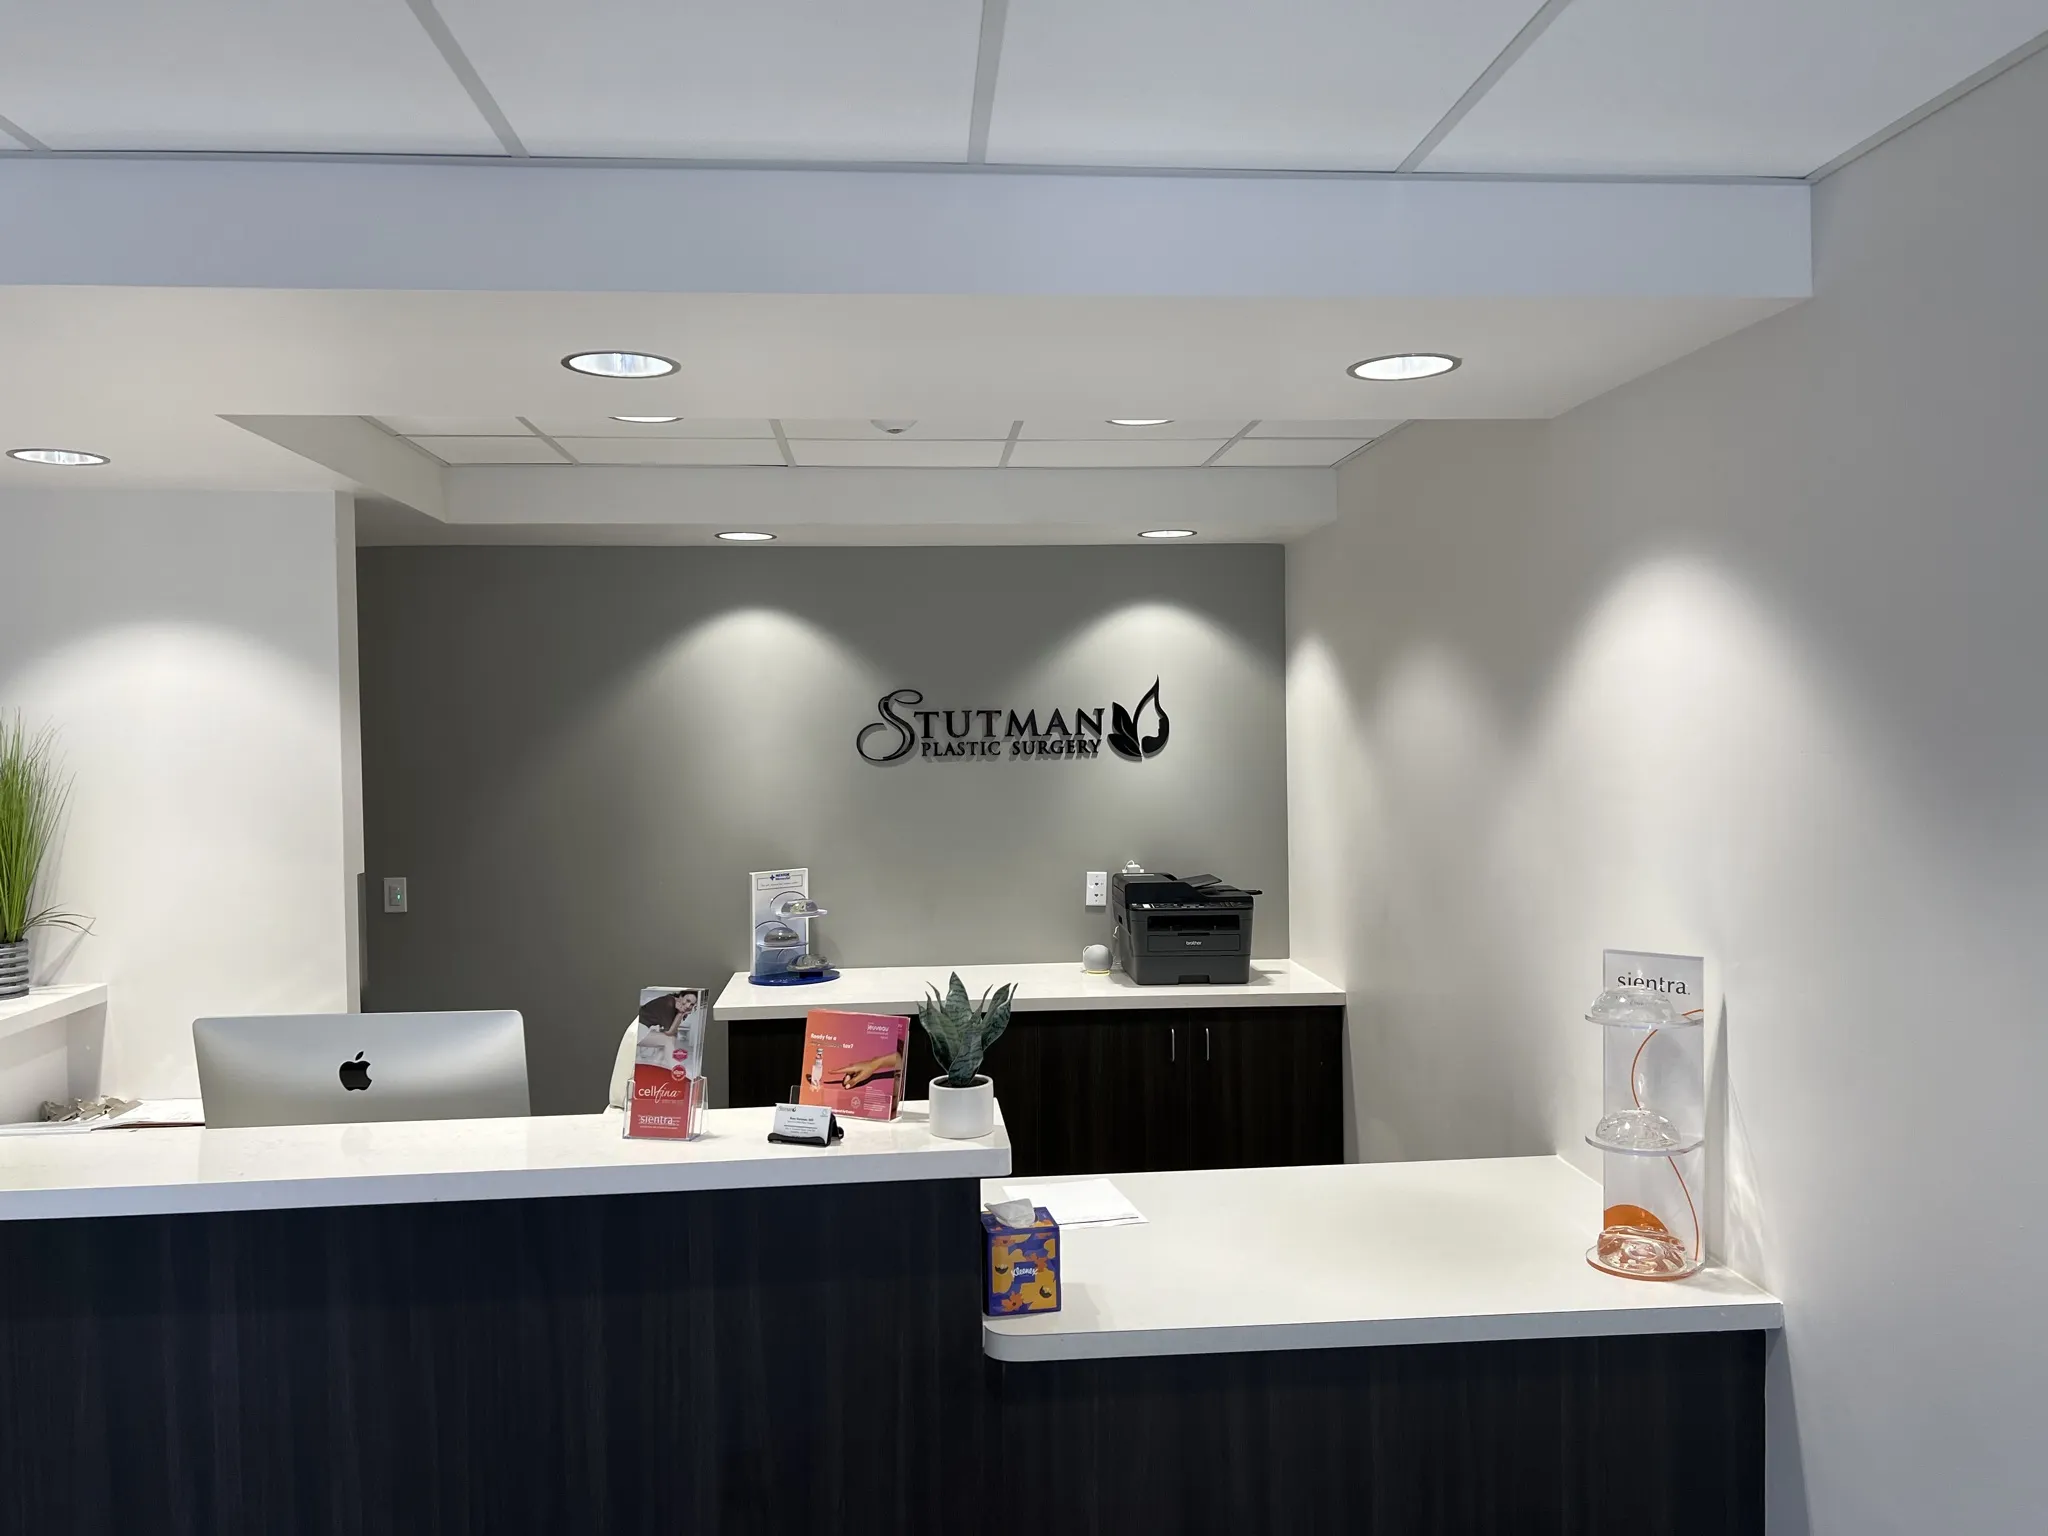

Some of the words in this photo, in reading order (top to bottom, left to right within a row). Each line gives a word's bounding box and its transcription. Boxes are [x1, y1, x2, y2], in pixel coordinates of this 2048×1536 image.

[921, 740, 1001, 757] PLASTIC
[1011, 739, 1102, 756] SURGERY
[1011, 1267, 1038, 1278] Kleenex
